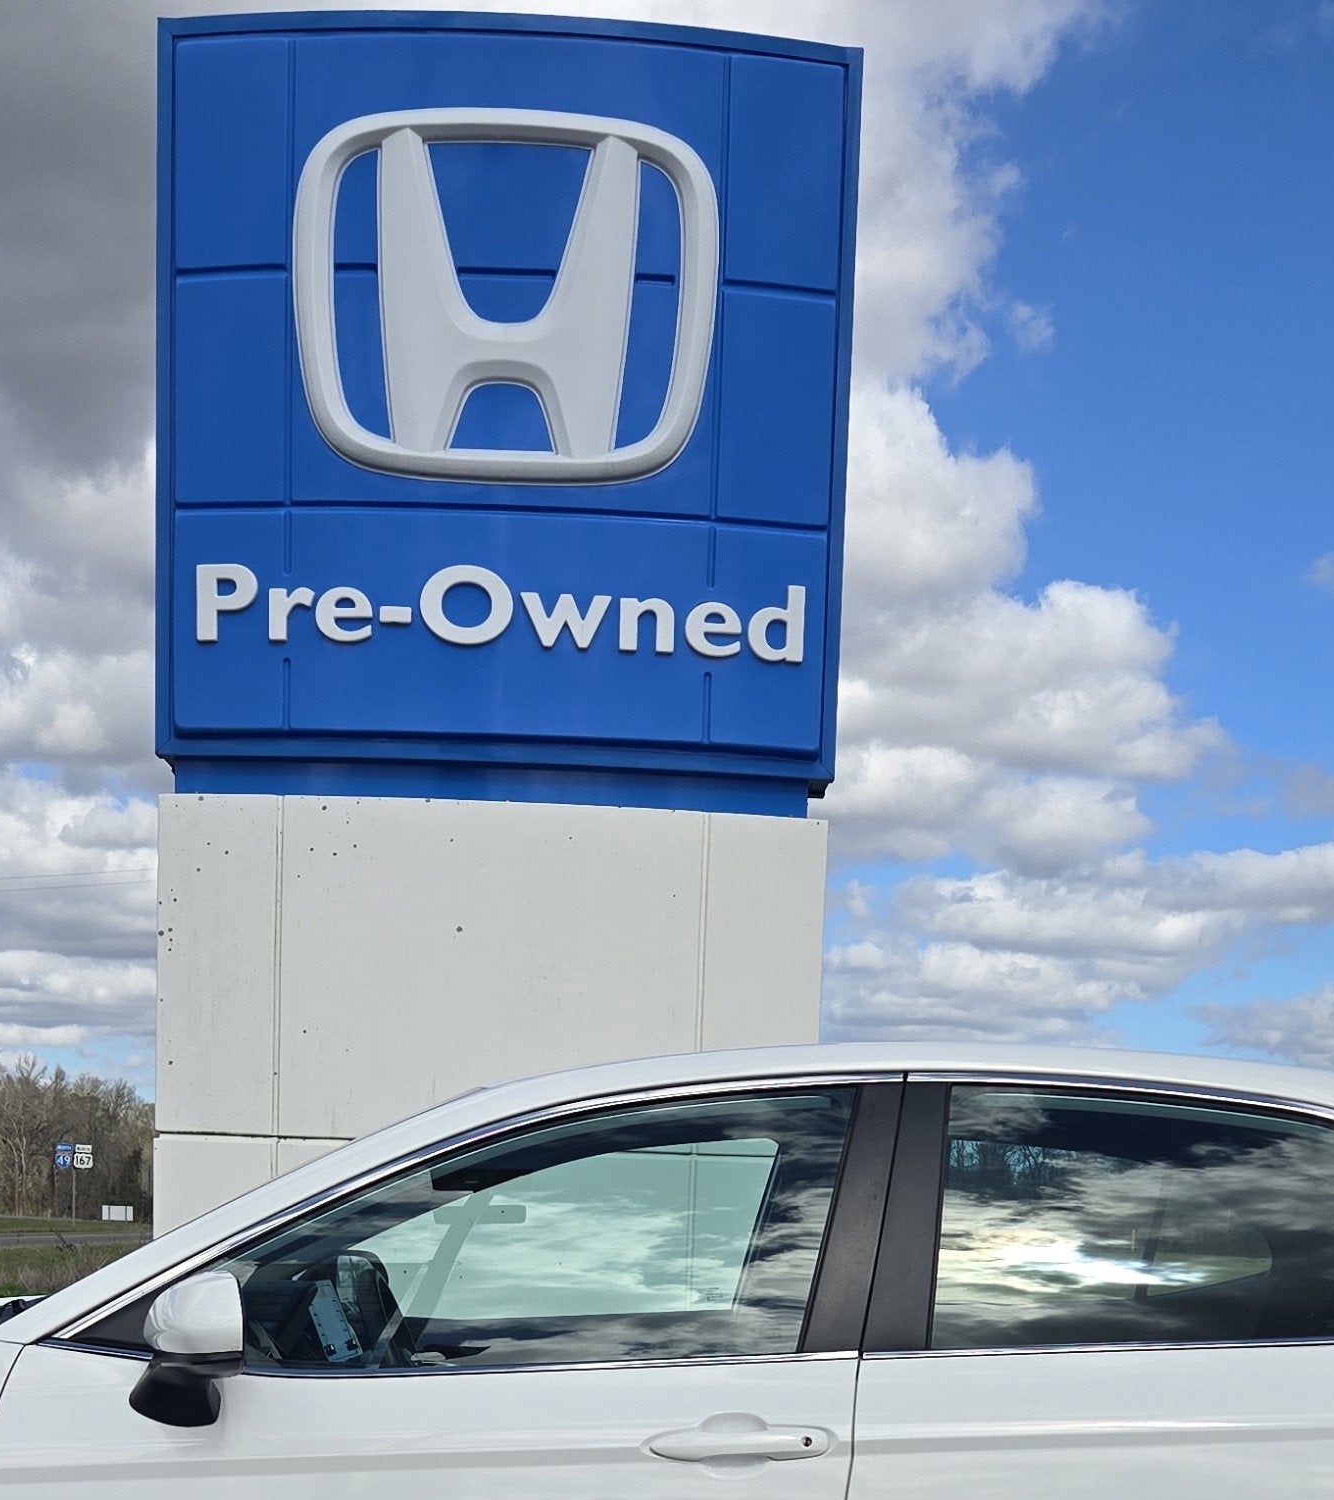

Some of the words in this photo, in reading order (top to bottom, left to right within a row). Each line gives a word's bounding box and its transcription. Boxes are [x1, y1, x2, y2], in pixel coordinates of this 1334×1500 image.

[195, 563, 807, 664] Pre-Owned
[57, 1155, 71, 1166] 49
[75, 1155, 92, 1166] 167
